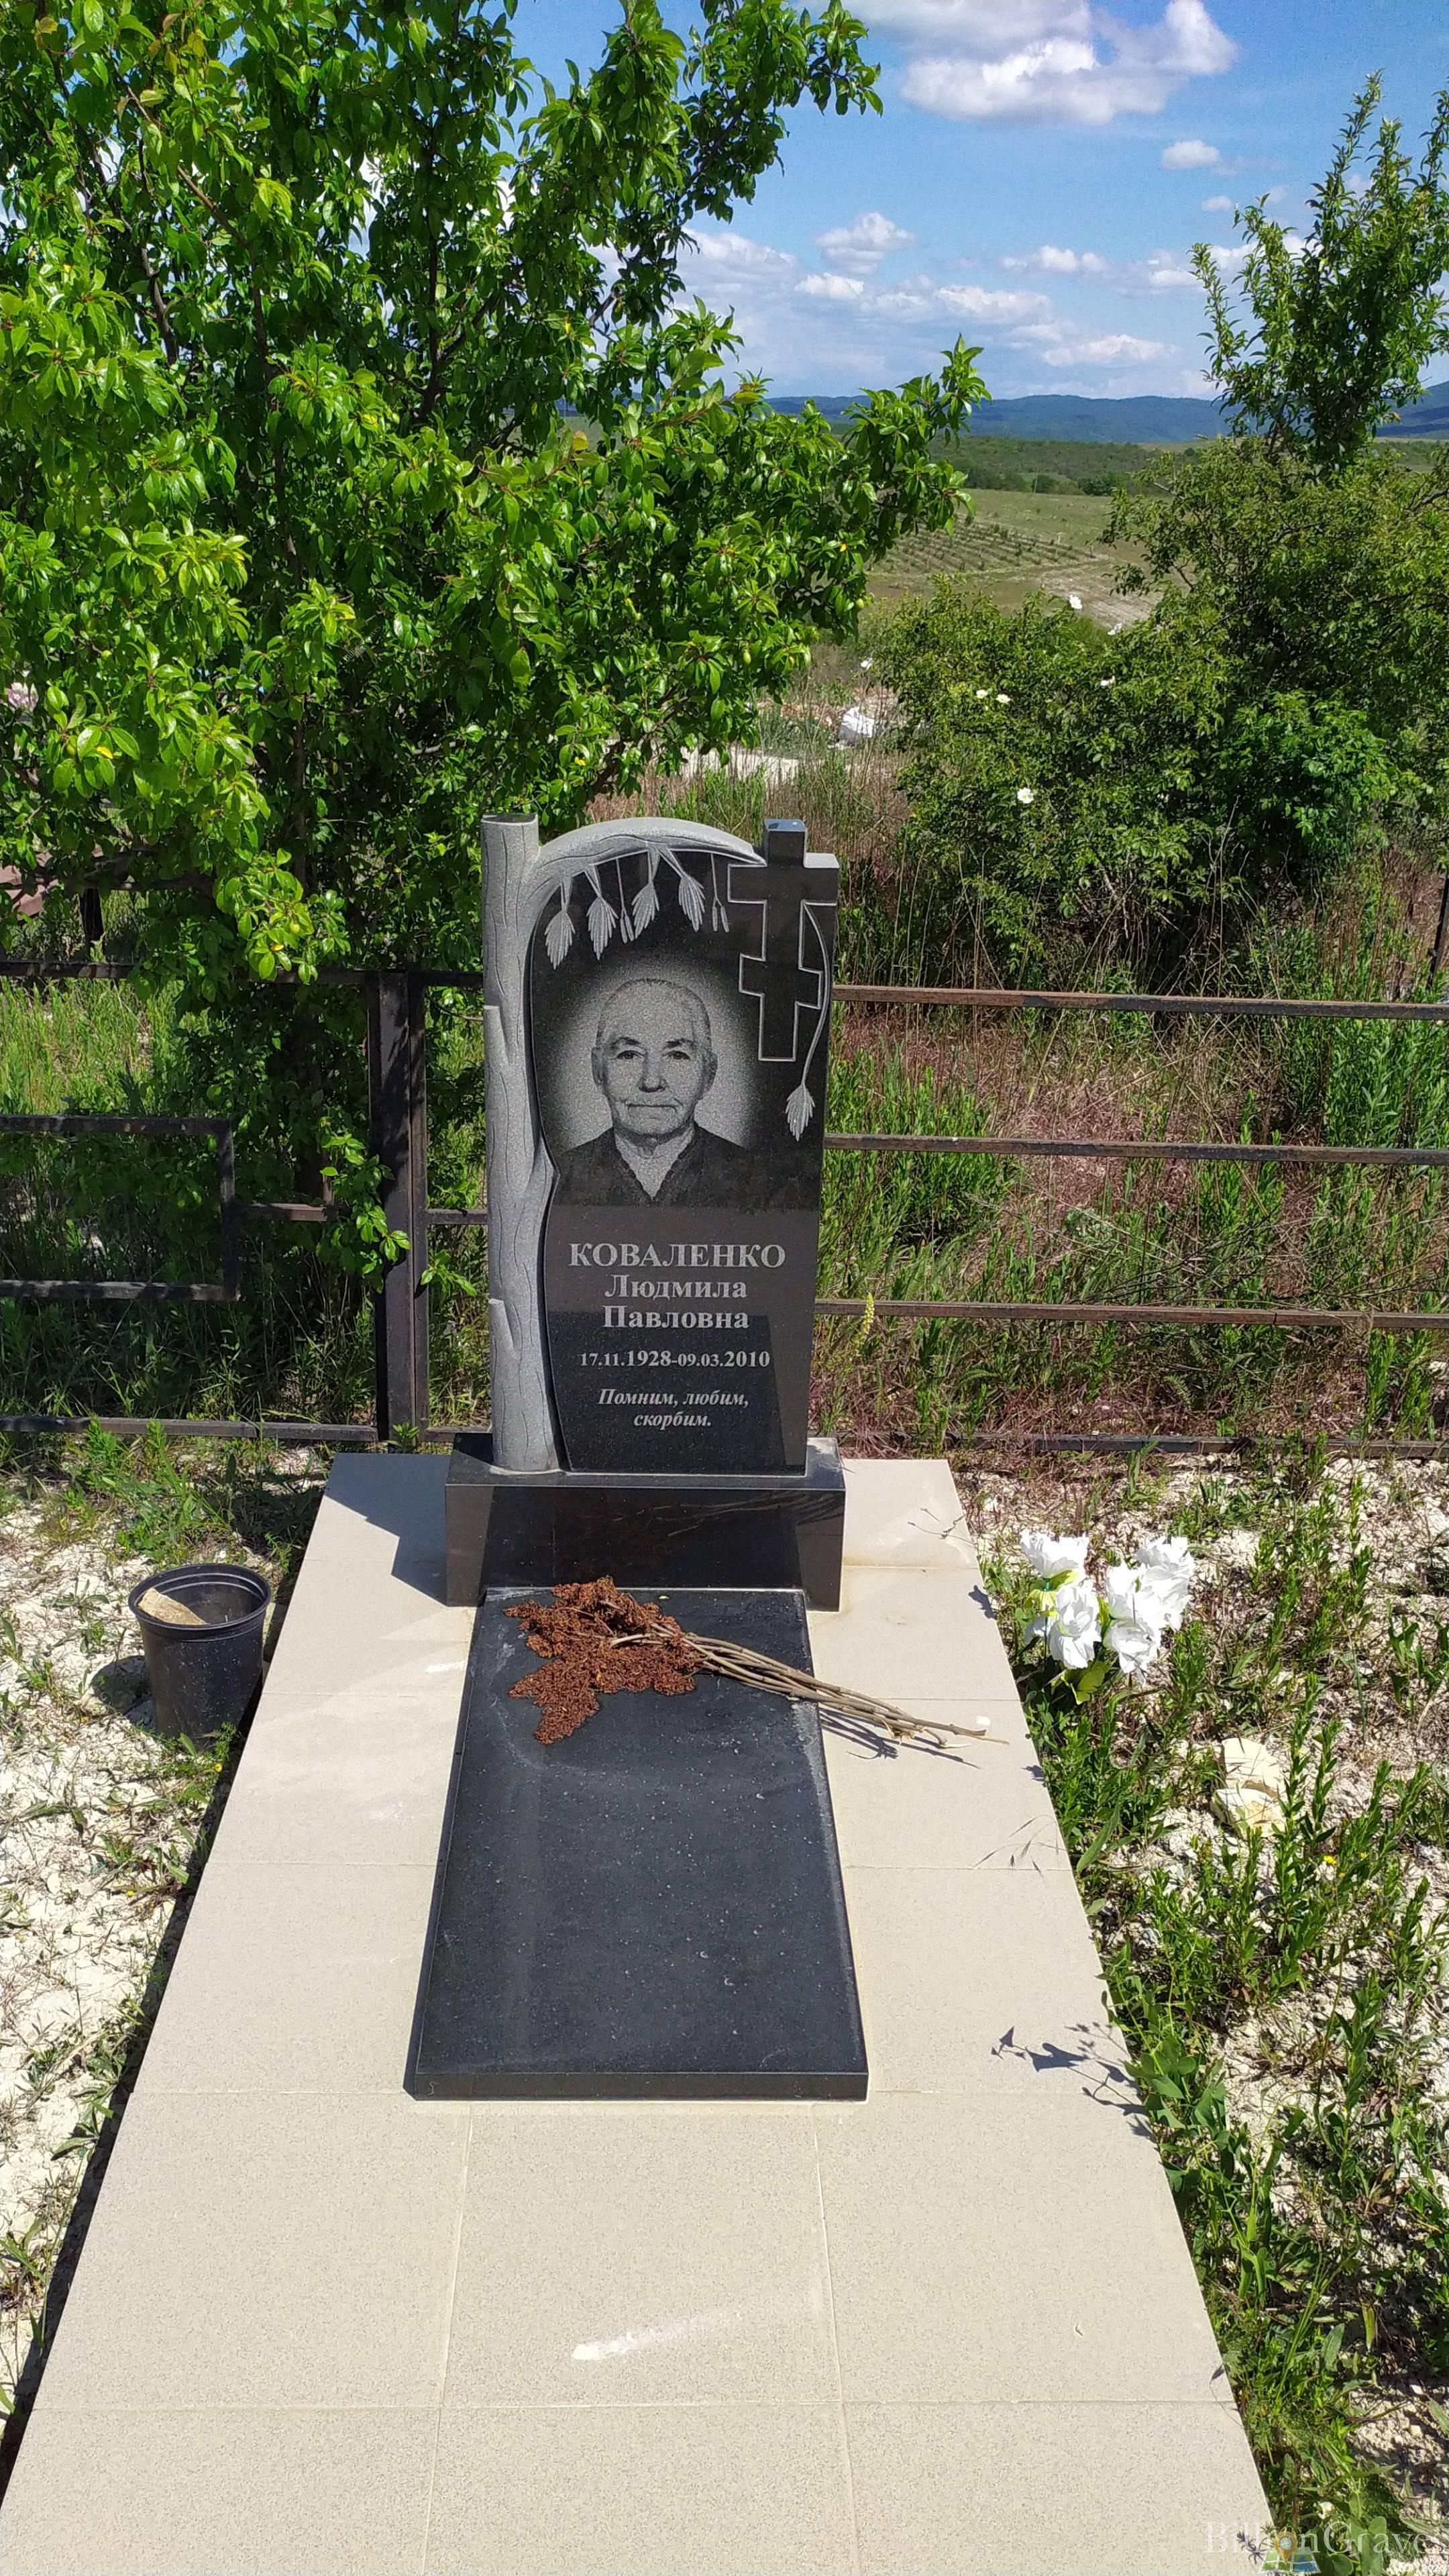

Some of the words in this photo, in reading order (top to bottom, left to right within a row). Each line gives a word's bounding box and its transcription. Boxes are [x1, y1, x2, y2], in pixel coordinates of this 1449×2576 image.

[568, 1243, 786, 1267] КОВАЛЕНКО
[604, 1274, 747, 1300] Людмила
[602, 1305, 749, 1329] Павловна
[580, 1350, 770, 1367] 17.11.1928-09.03.2010
[597, 1388, 678, 1407] Помним,
[682, 1390, 749, 1408] любим,
[633, 1411, 712, 1430] скорбим.
